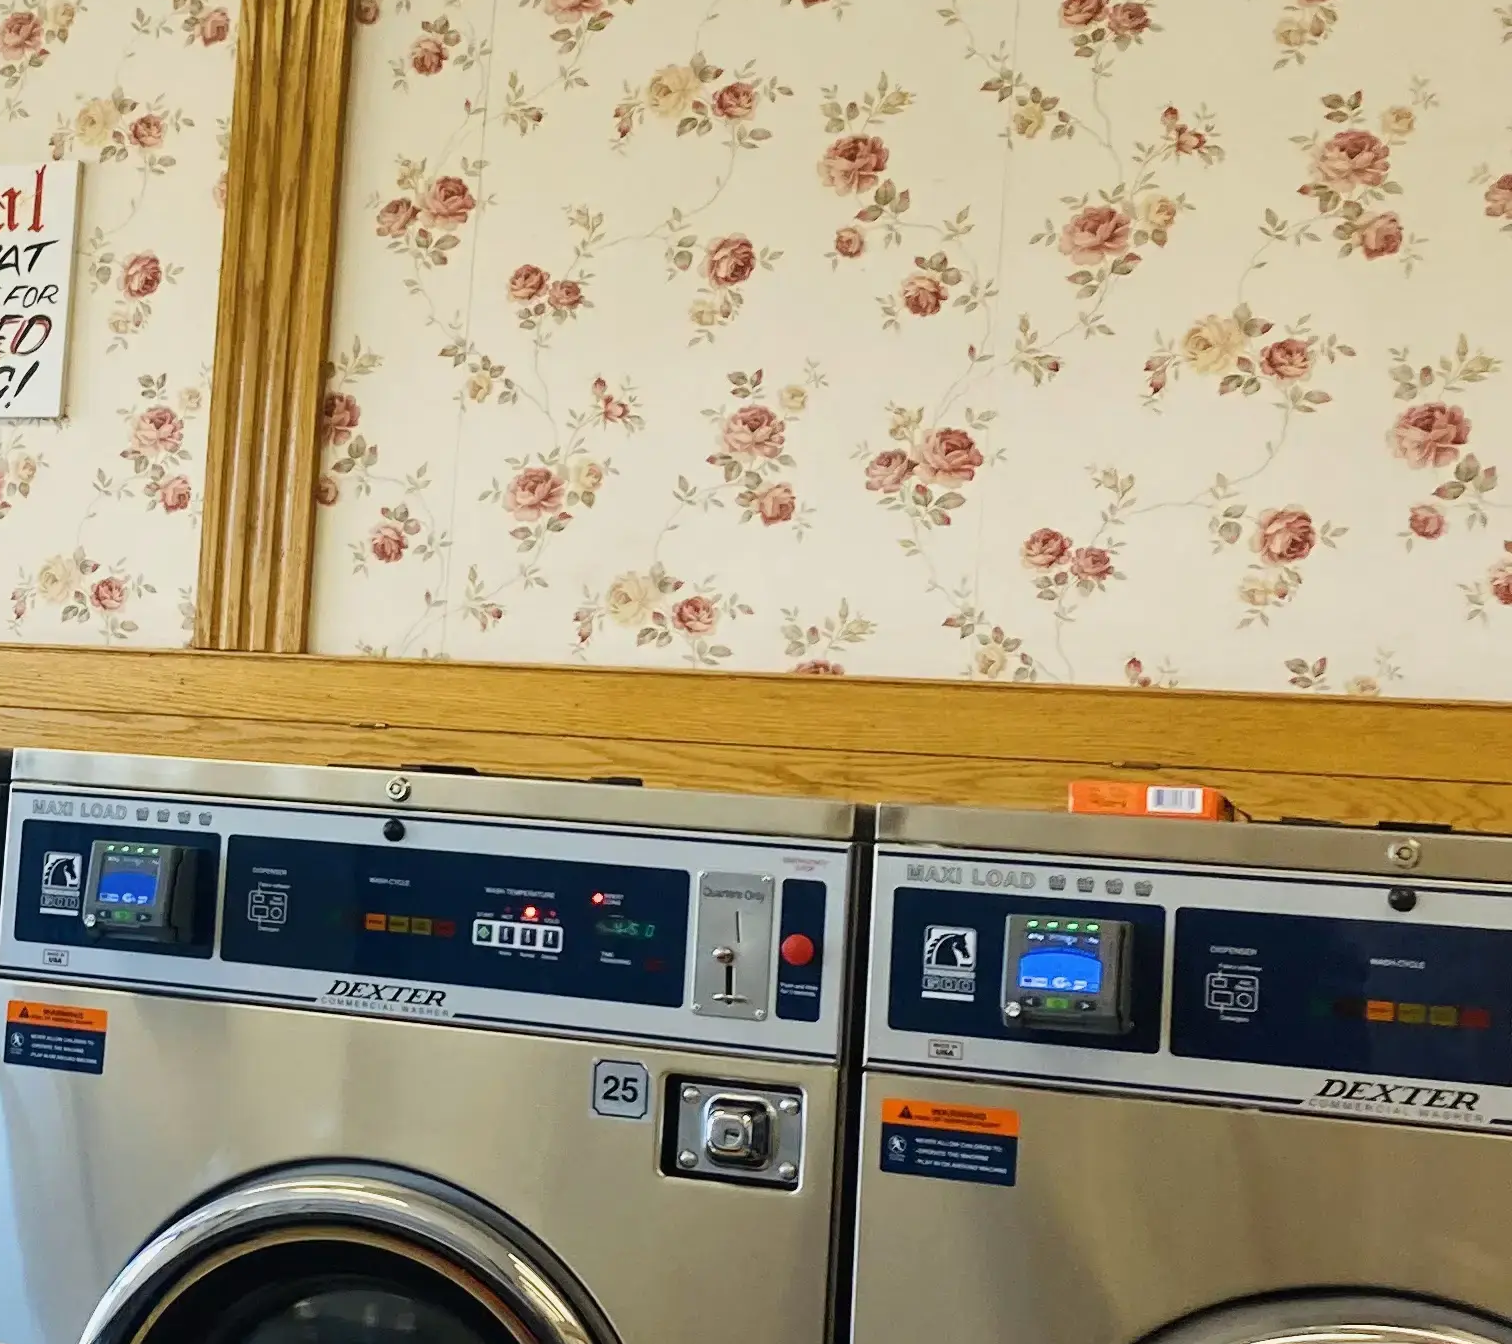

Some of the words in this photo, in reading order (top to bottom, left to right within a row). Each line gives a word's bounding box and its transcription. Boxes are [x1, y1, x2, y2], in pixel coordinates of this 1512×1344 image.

[4, 284, 60, 305] FOR
[32, 798, 74, 817] MAXI
[80, 801, 128, 820] LOAD
[906, 863, 962, 885] MAXI
[971, 867, 1037, 890] LOAD
[326, 979, 447, 1007] DEXTER
[320, 997, 395, 1012] COMMERCIAL
[401, 1005, 450, 1018] WASHER
[602, 1075, 640, 1105] 25
[1315, 1078, 1480, 1112] DEXTER
